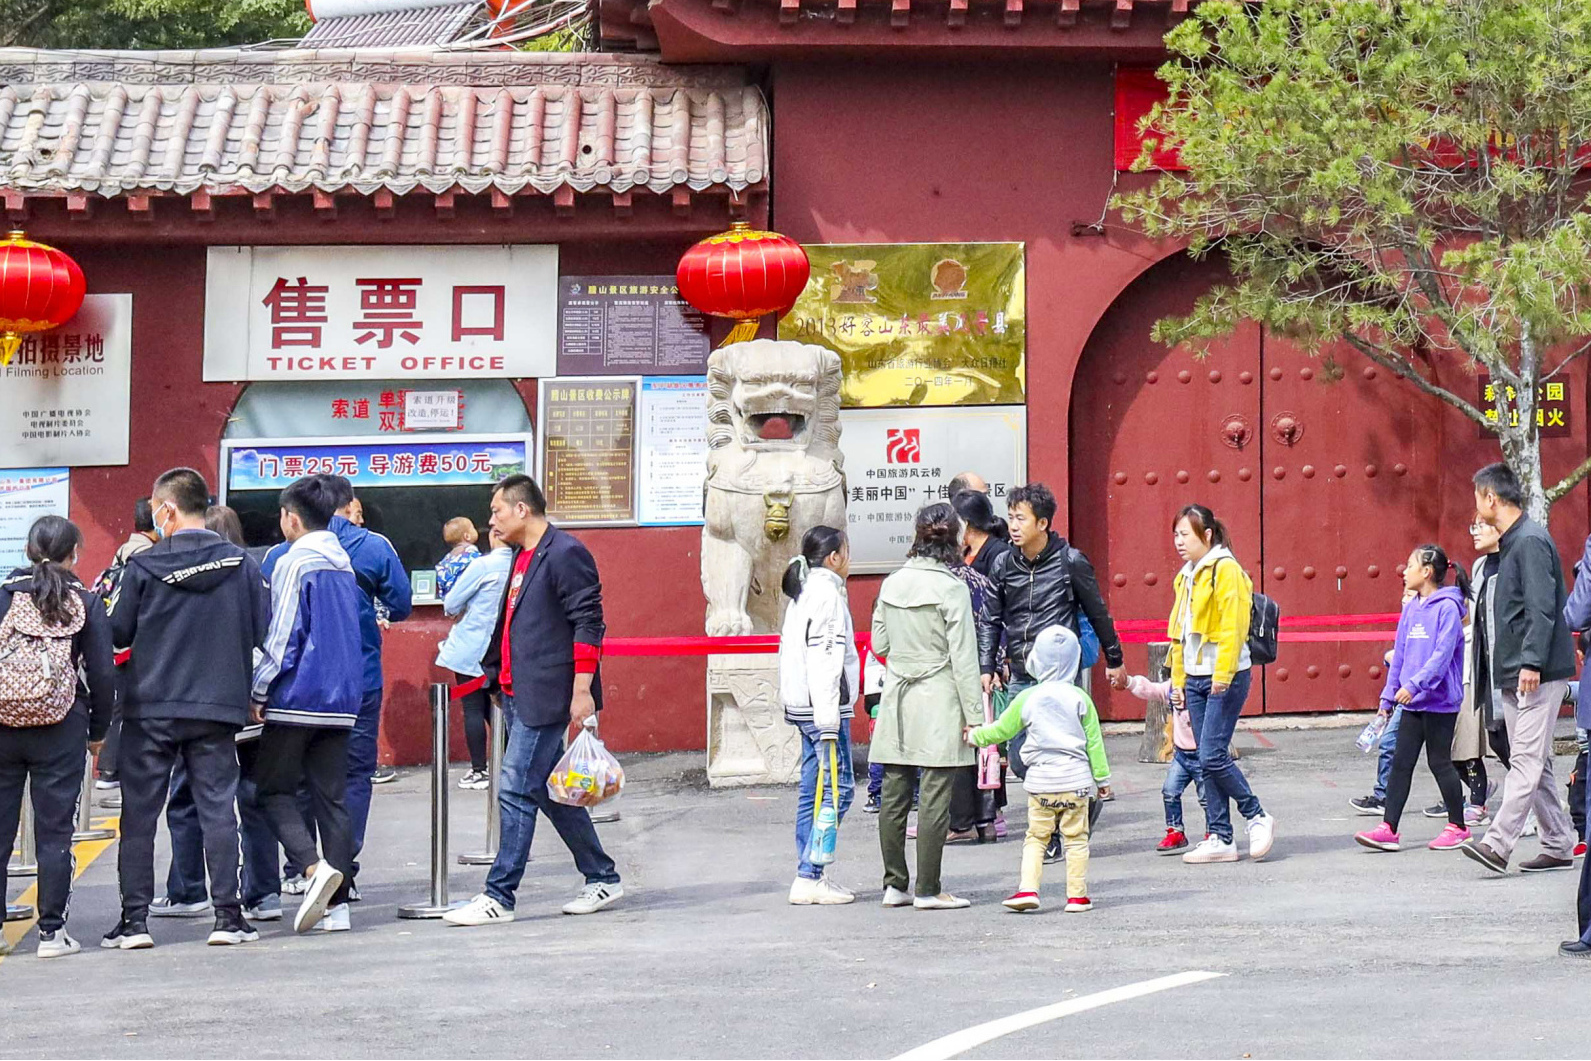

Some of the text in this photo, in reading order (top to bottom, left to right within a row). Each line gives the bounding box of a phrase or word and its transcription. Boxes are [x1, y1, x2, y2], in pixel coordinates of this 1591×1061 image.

[262, 276, 505, 349] 售票口
[8, 333, 105, 366] 拍摄景地
[6, 367, 49, 379] Filming
[53, 365, 104, 377] Location
[266, 356, 505, 371] TICKET OFFICE
[331, 399, 370, 419] 索道
[258, 452, 493, 477] 门票25元 导游费50元
[865, 467, 942, 479] 中国旅游风云榜
